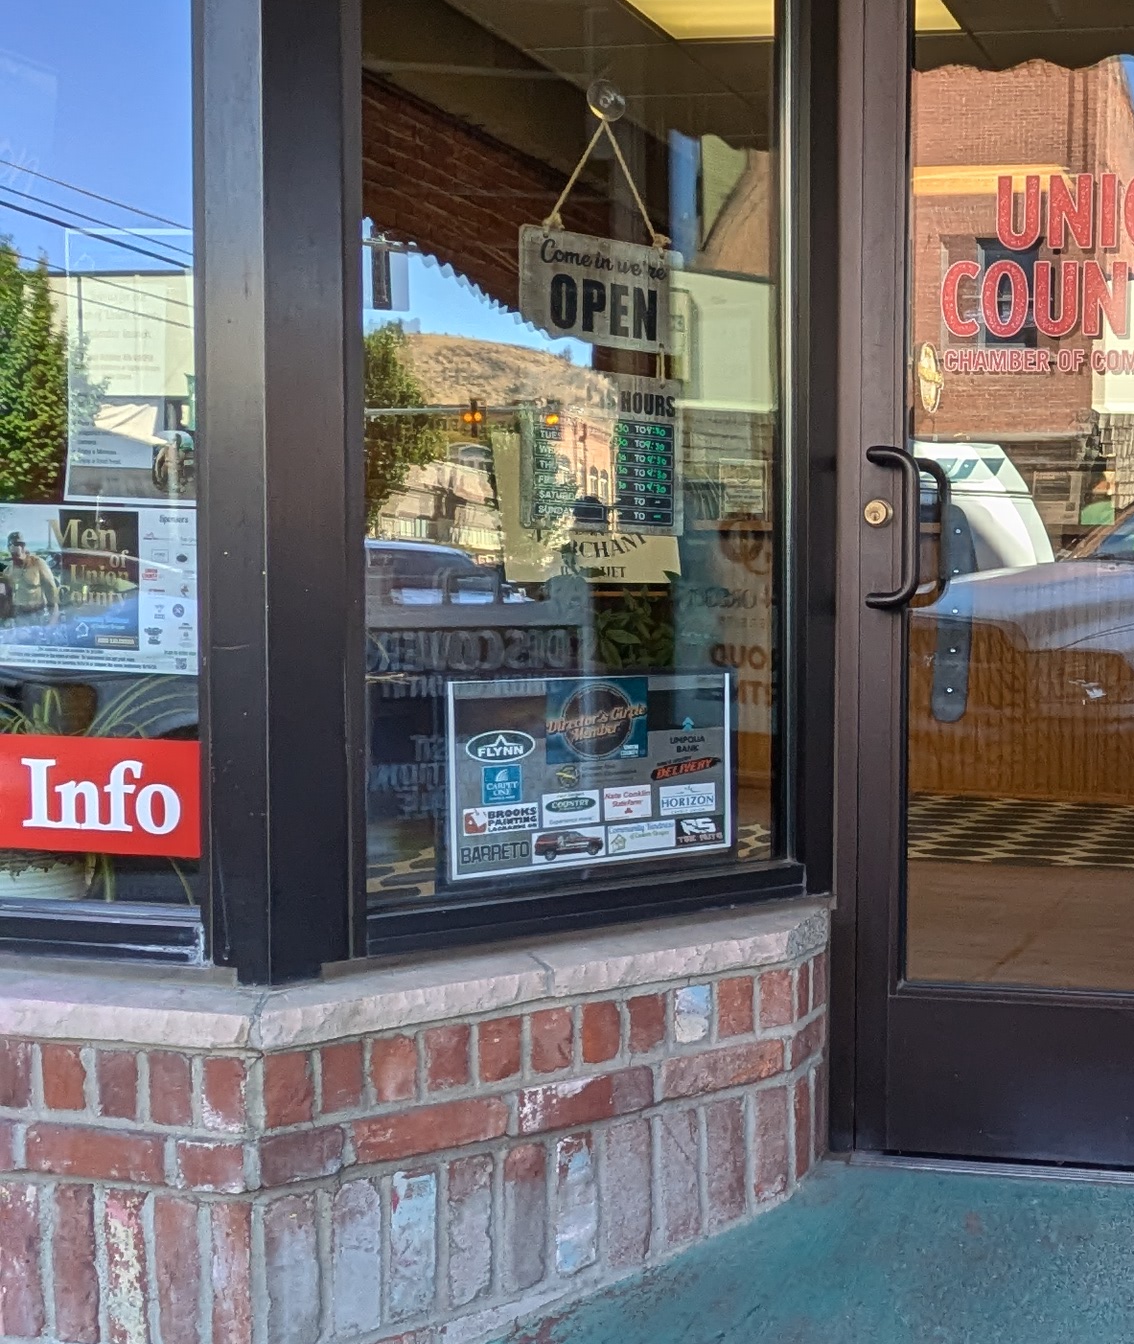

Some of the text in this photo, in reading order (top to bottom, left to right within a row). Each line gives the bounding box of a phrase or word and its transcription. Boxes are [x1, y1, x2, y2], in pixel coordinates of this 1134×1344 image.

[540, 238, 668, 281] Come in we're
[551, 273, 658, 341] OPEN
[943, 348, 1051, 373] CHAMBER
[1057, 348, 1085, 372] OF
[620, 390, 676, 418] HOURS
[634, 425, 646, 434] TO
[634, 439, 646, 448] TO
[634, 454, 646, 463] TO
[634, 468, 646, 477] TO
[634, 483, 646, 492] TO
[634, 497, 646, 506] TO
[538, 504, 646, 520] SUNDAY TO
[159, 514, 188, 525] Sponsors
[47, 518, 118, 552] Men
[109, 549, 129, 568] of
[70, 564, 129, 584] Union
[59, 585, 127, 607] County
[547, 704, 647, 735] Director's Circle
[571, 723, 621, 743] Member
[670, 735, 705, 745] UMPQUA
[477, 743, 524, 758] FLYNN
[676, 745, 699, 753] BANK
[656, 758, 713, 780] DELIVERY
[486, 781, 518, 790] CARPET
[21, 757, 181, 835] Info
[623, 790, 651, 798] Conklin
[551, 798, 590, 809] COUNTRY
[661, 795, 714, 809] HORIZON
[488, 807, 537, 819] BROOKS
[488, 816, 537, 826] PAINTING
[610, 825, 645, 835] Community
[460, 841, 530, 864] BARRETO
